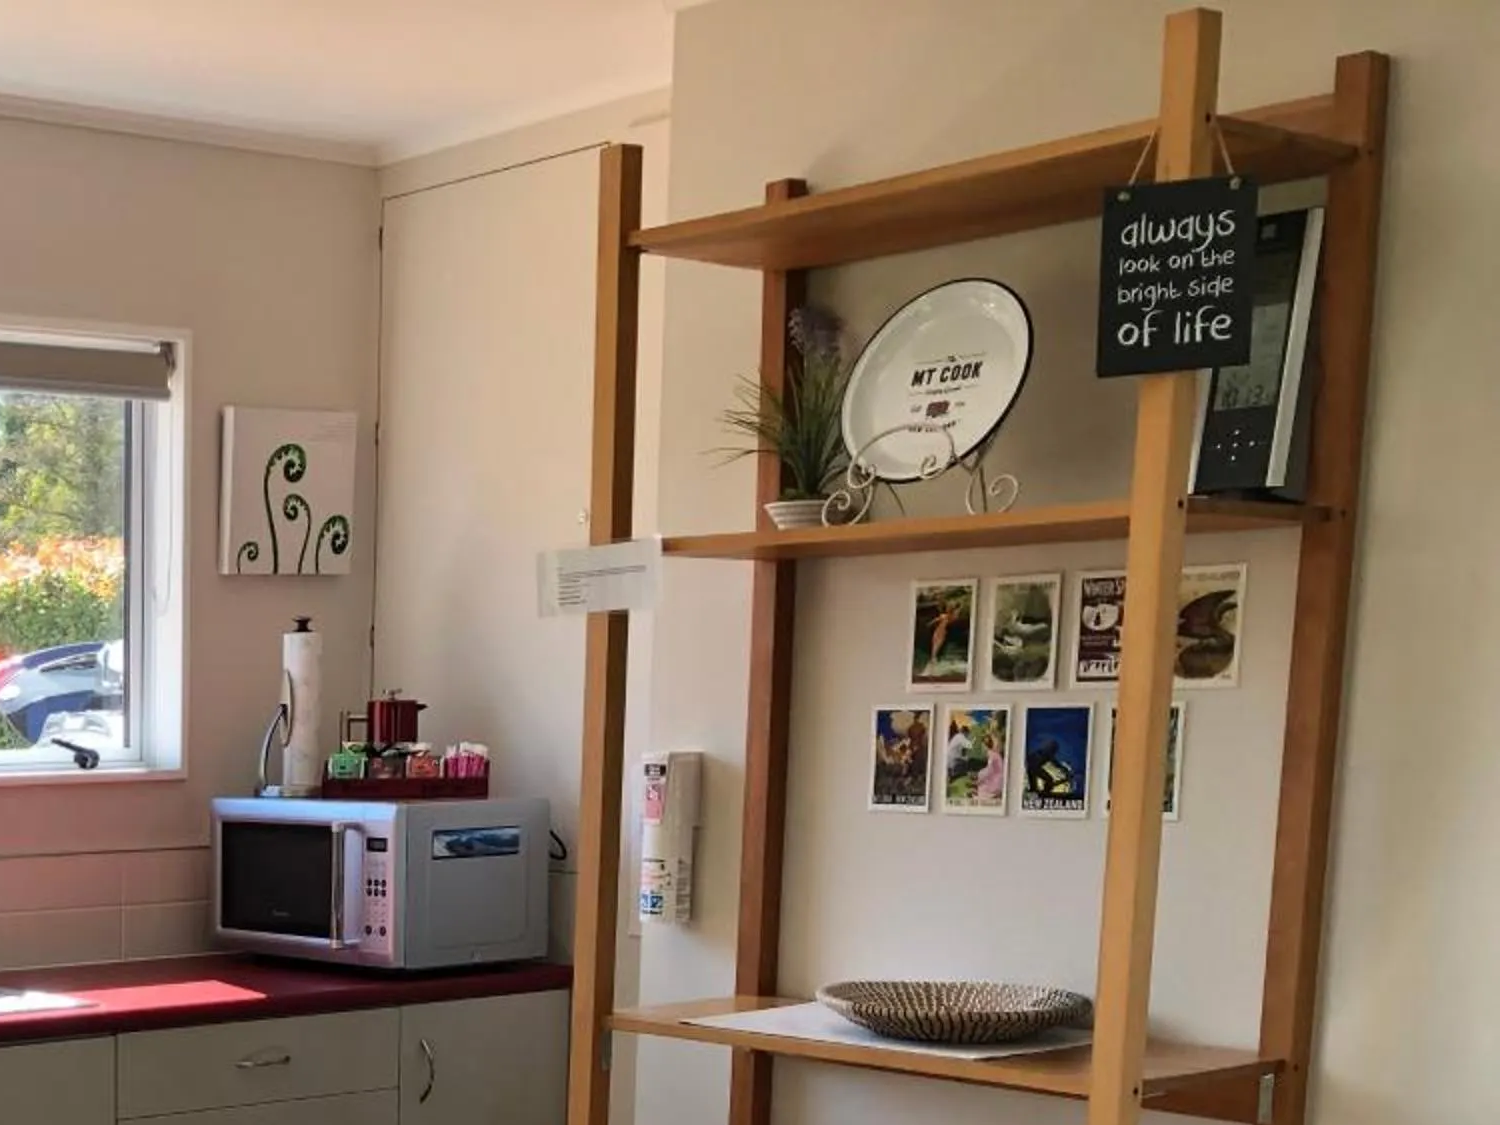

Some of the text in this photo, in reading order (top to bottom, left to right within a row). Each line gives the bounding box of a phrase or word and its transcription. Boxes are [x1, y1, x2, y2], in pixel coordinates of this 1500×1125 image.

[1120, 209, 1236, 253] always
[1118, 249, 1236, 275] look on the
[1117, 275, 1234, 311] bright side
[1117, 305, 1233, 348] of life
[911, 361, 983, 386] MT COOK
